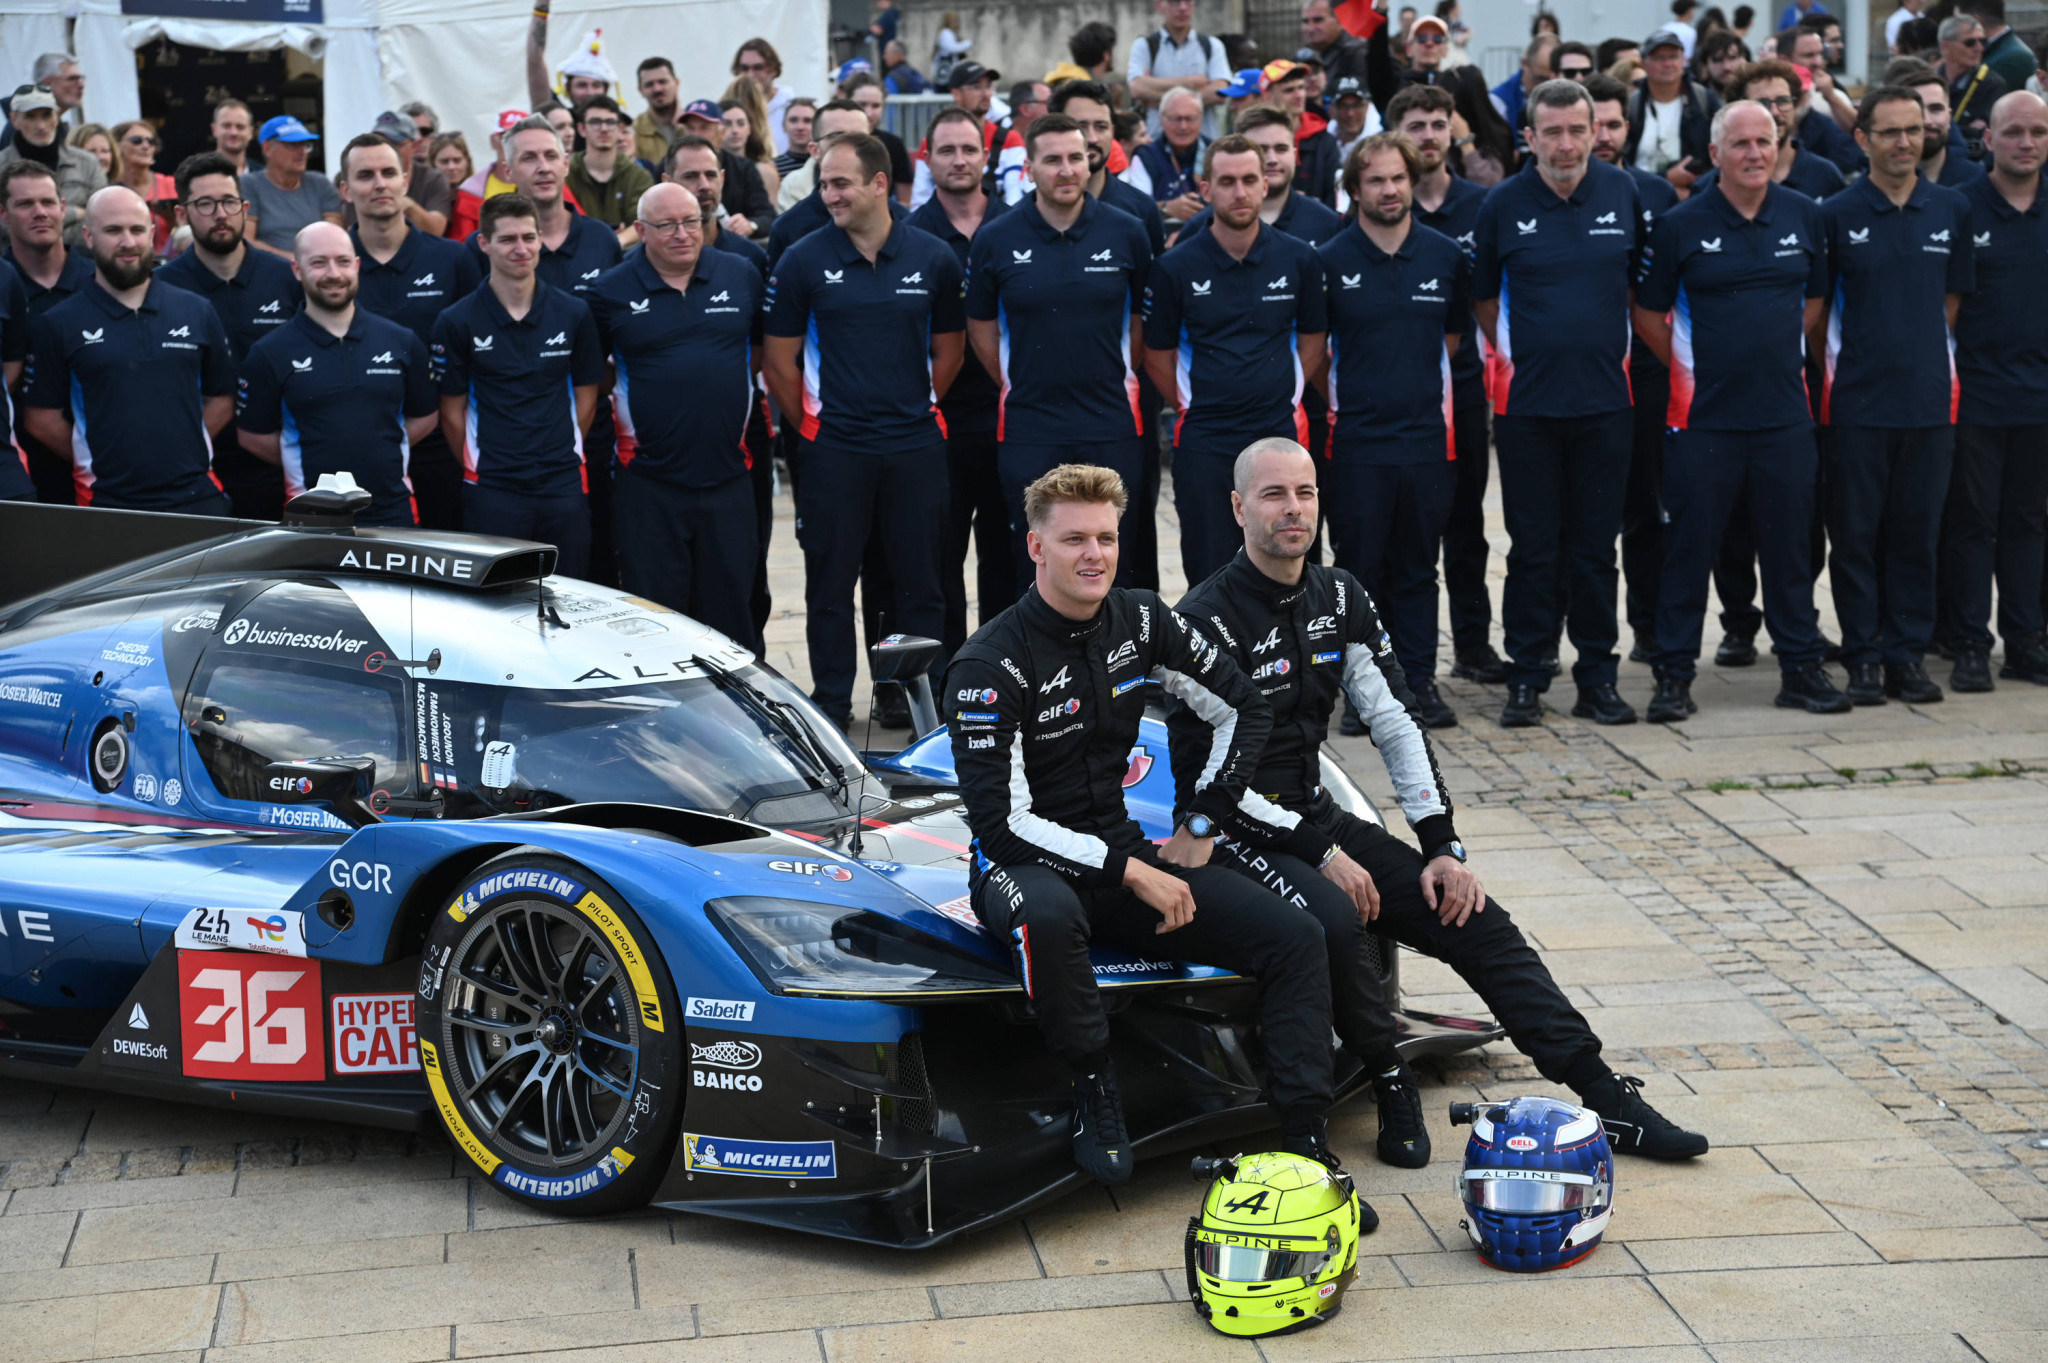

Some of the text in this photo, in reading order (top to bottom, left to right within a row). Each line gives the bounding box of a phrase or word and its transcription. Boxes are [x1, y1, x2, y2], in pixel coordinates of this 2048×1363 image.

[339, 549, 473, 579] ALPINE
[1335, 579, 1346, 616] Sabelt
[1140, 603, 1150, 643] Sabelt
[1210, 615, 1238, 649] Sabelt
[115, 641, 149, 655] CHEOPS
[246, 622, 368, 654] businessolver
[100, 649, 155, 667] TECHNOLOGY
[571, 639, 747, 683] ALPIN
[1000, 657, 1029, 690] Sabelt
[1251, 662, 1275, 680] elf
[957, 688, 981, 702] elf
[417, 682, 429, 761] M.SCHUMACHER
[1038, 703, 1065, 723] elf
[430, 691, 442, 763] F.MAKOWIECKI
[442, 712, 455, 766] J.GOUNON
[968, 734, 996, 749] ixell
[269, 776, 296, 792] elf
[329, 858, 393, 895] GCR
[768, 860, 821, 876] elf
[479, 871, 575, 900] MICHELIN
[193, 907, 230, 935] 24h
[192, 931, 203, 940] LE
[203, 932, 229, 943] MANS
[587, 902, 639, 966] PILOT SPORT
[189, 967, 307, 1065] 36
[641, 1001, 660, 1023] M
[692, 999, 748, 1020] Sabelt
[113, 1038, 168, 1060] DEWESoft
[423, 1047, 437, 1068] M
[693, 1069, 763, 1092] BAHCO
[441, 1102, 489, 1166] PILOT SPORT
[1511, 1138, 1534, 1147] BELL
[723, 1151, 831, 1168] MICHELIN
[504, 1169, 599, 1197] MICHELIN
[1481, 1170, 1561, 1181] ALPINE
[1202, 1232, 1292, 1251] ALPINE
[1320, 1285, 1336, 1296] BELL
